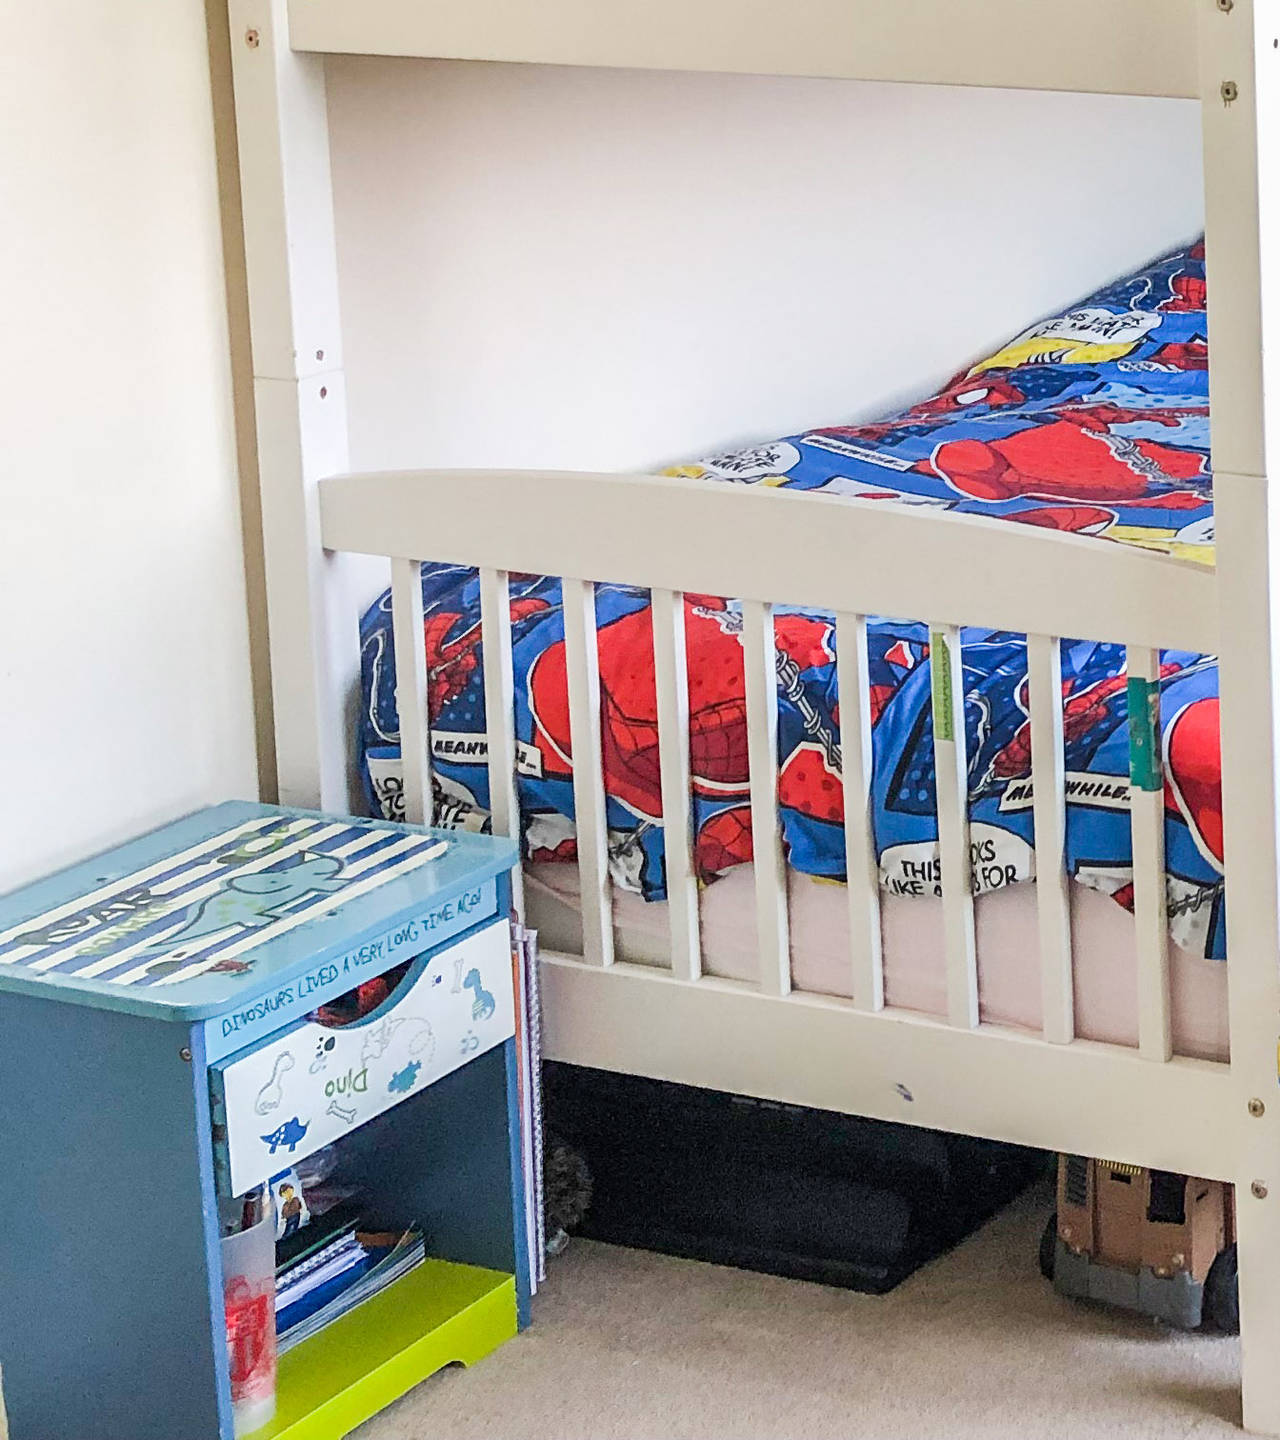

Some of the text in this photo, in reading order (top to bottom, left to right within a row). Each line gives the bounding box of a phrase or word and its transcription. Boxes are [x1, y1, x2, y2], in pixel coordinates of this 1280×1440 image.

[221, 987, 294, 1037] DINOSAURS
[298, 964, 339, 998] LIVED
[343, 956, 350, 974] A
[352, 940, 385, 965] VERY
[387, 921, 419, 953] LONG
[423, 903, 455, 931] TIME
[324, 1068, 368, 1098] Dino
